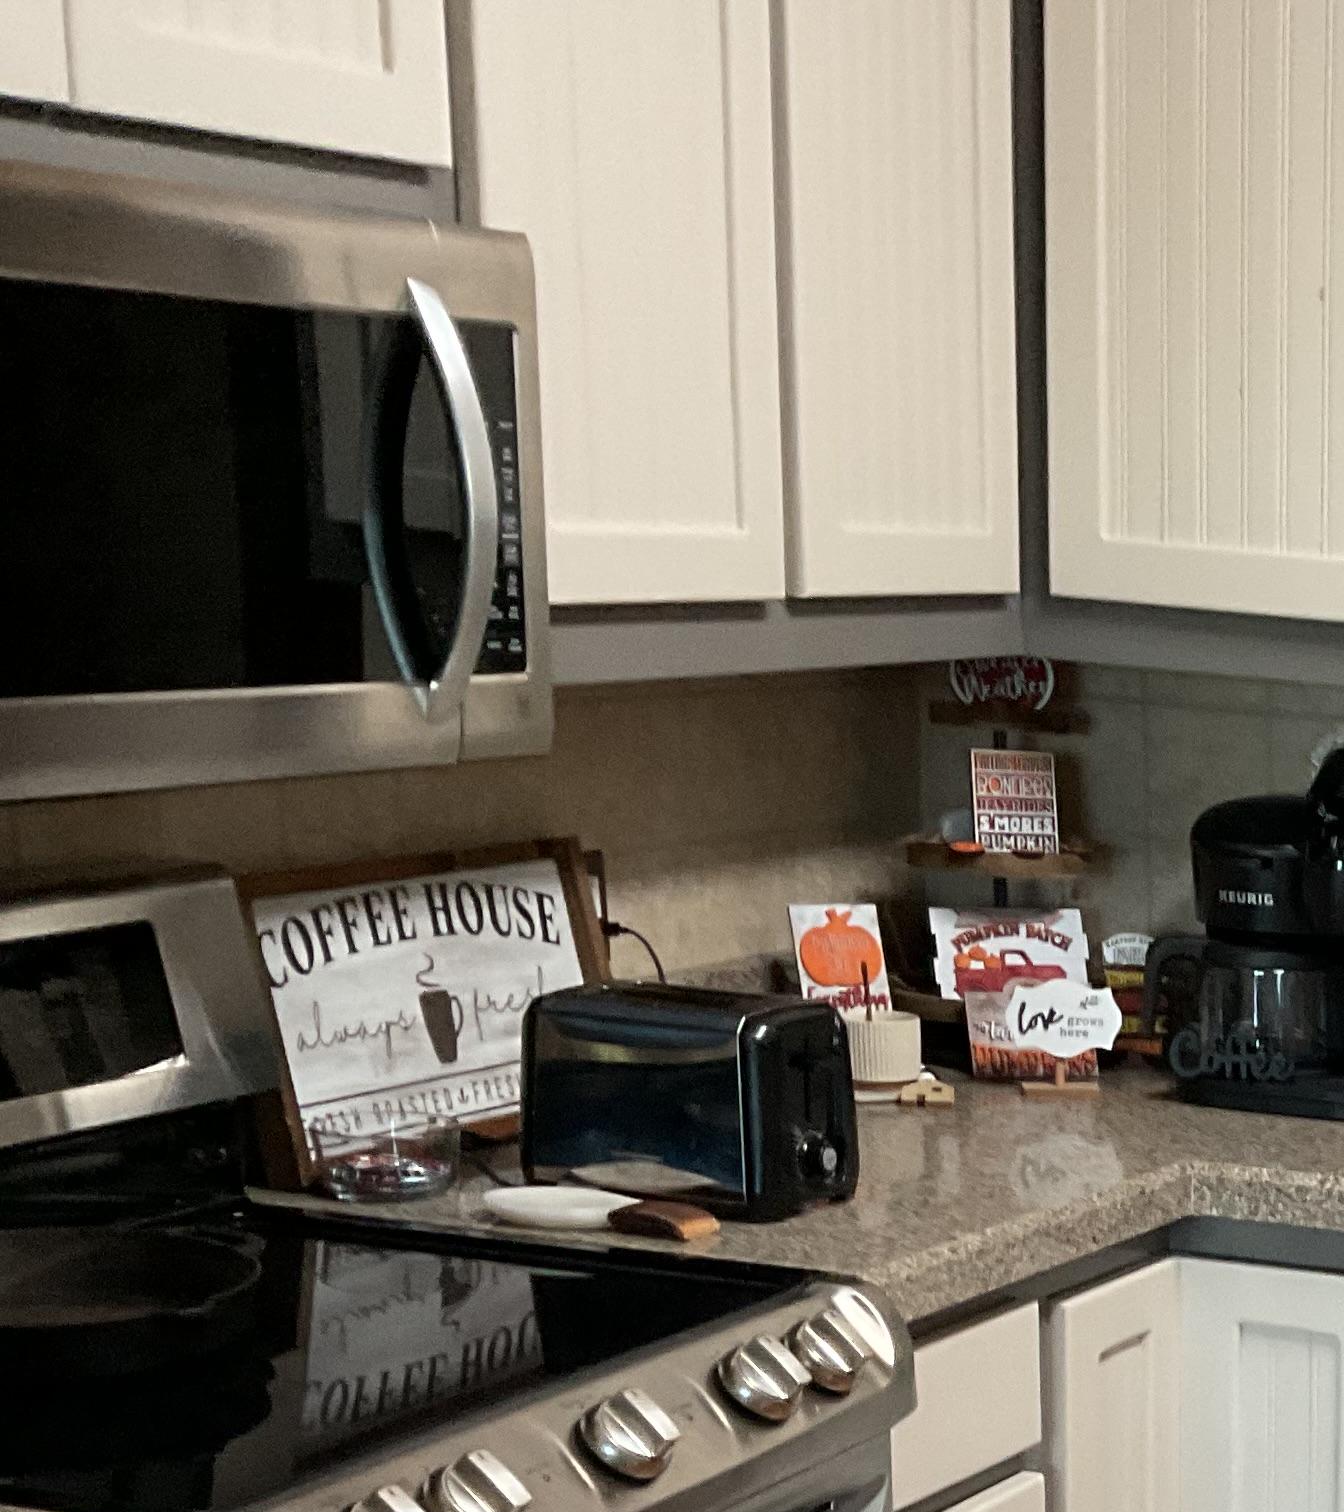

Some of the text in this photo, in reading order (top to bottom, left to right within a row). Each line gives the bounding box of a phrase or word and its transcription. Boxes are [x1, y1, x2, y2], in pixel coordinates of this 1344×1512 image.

[979, 814, 1054, 833] S'MORES
[1219, 889, 1274, 907] KEURIG
[259, 880, 561, 988] COFFEE HOUSE
[297, 1001, 416, 1059] always
[1060, 1026, 1089, 1038] here
